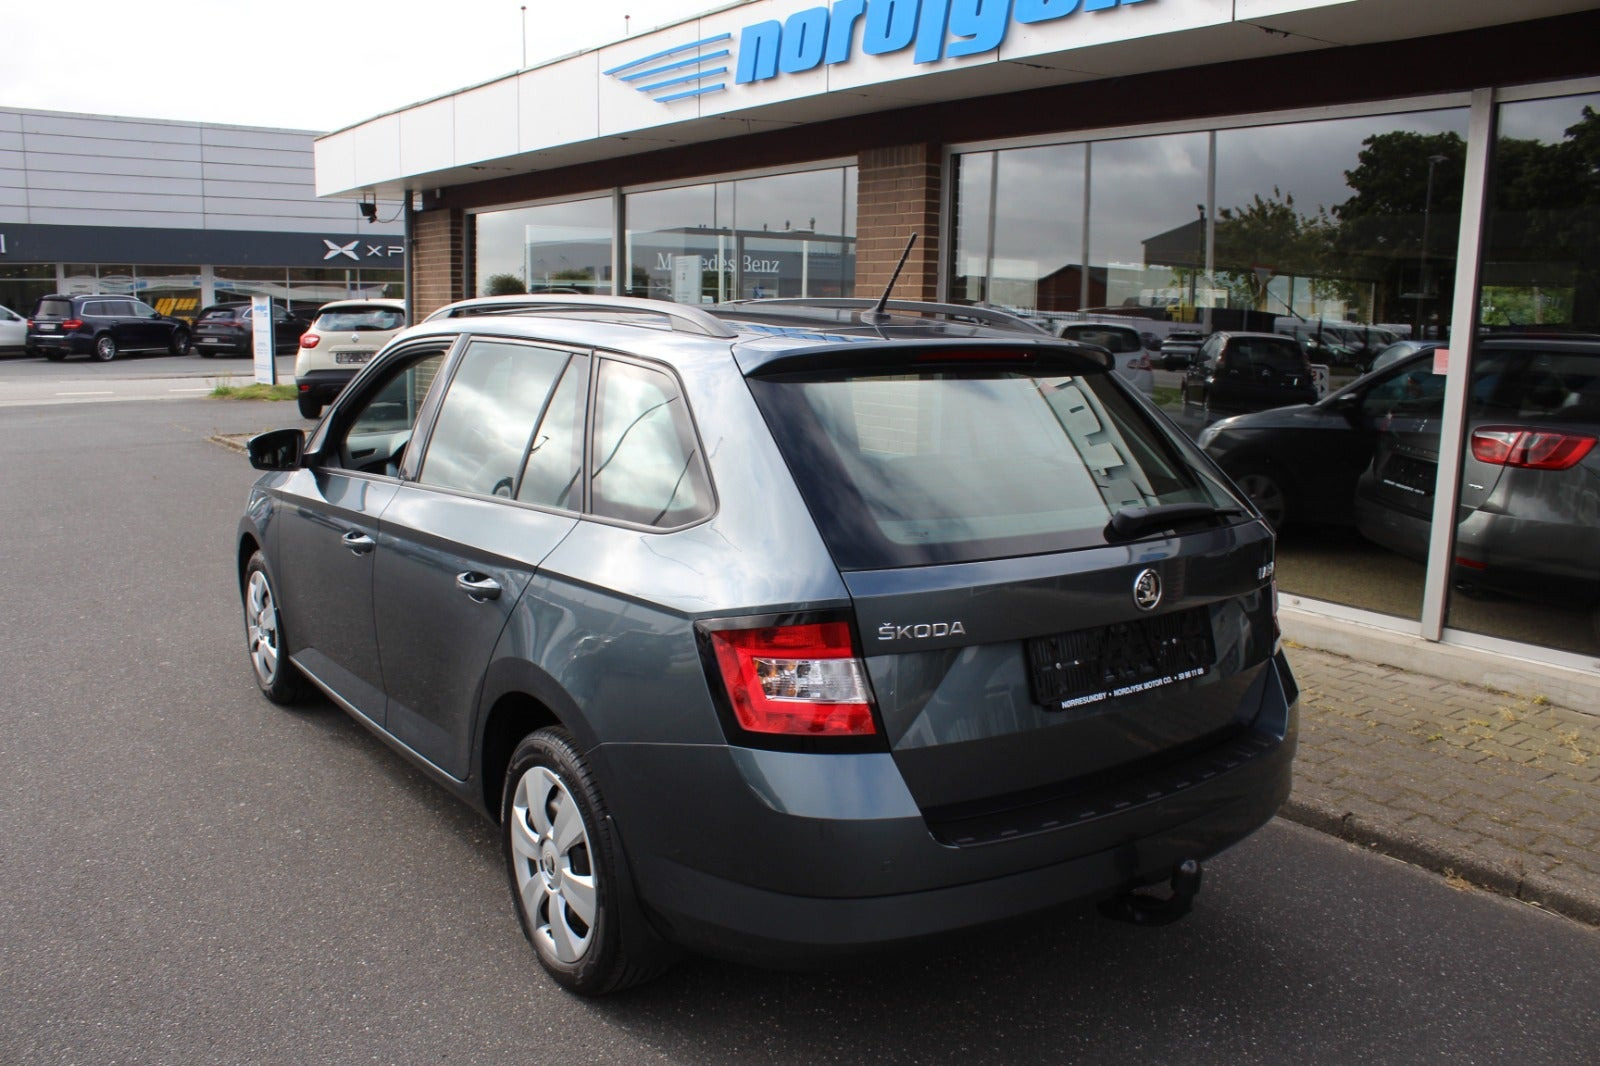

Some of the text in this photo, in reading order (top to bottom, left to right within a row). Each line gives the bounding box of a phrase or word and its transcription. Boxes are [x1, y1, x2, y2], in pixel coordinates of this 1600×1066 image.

[736, 0, 1147, 84] nordjy
[878, 622, 966, 640] ŠKODA
[1113, 684, 1144, 697] NORDJYSK
[1144, 678, 1163, 690] MOTOR
